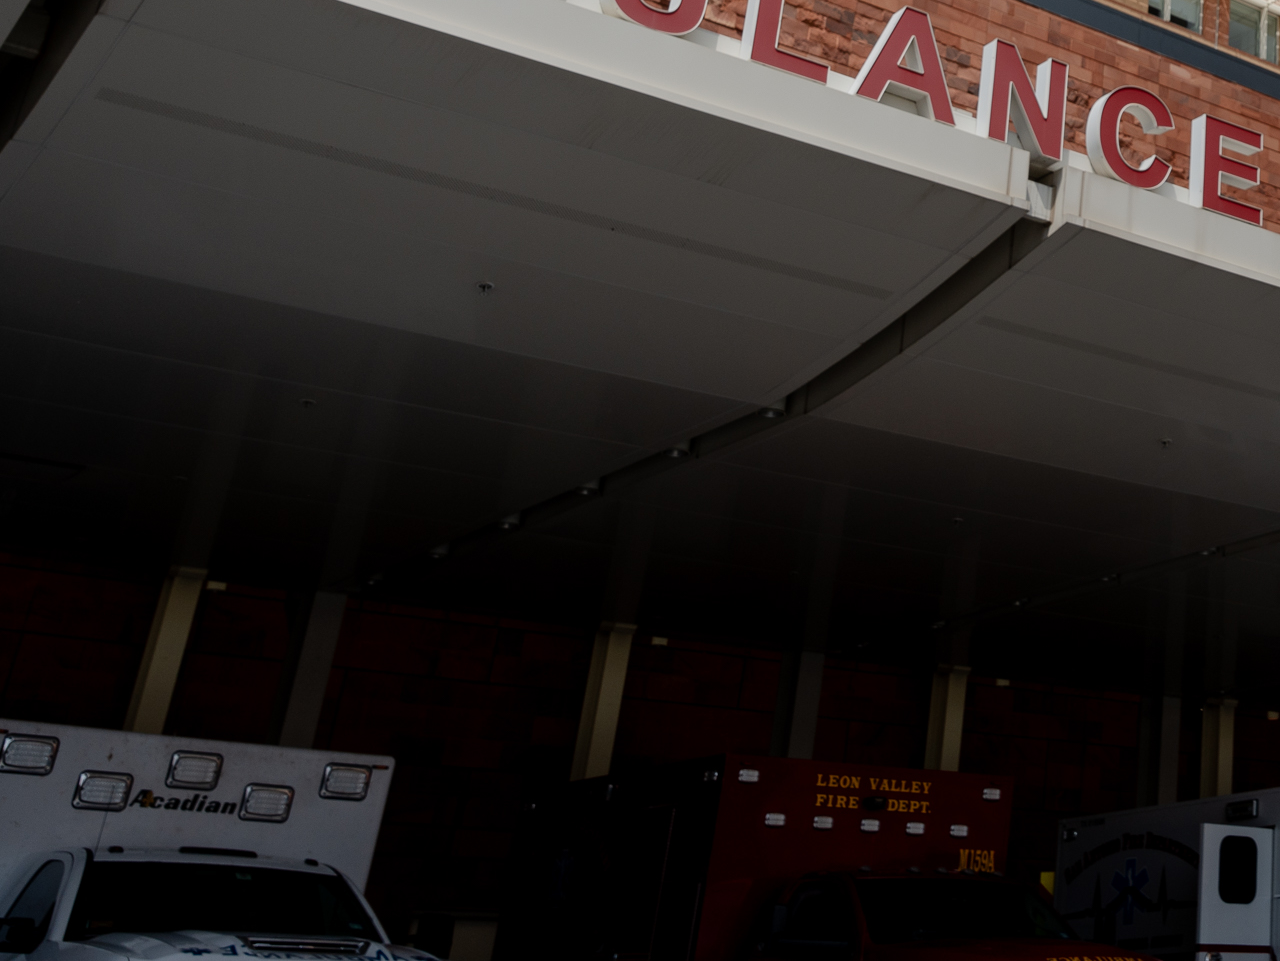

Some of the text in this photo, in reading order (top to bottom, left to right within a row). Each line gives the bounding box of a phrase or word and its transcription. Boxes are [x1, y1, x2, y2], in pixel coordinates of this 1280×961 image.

[816, 773, 932, 794] LEON VALLEY
[129, 789, 238, 815] Acadian
[815, 793, 932, 814] FIRE DEPT.
[957, 848, 996, 873] M159A
